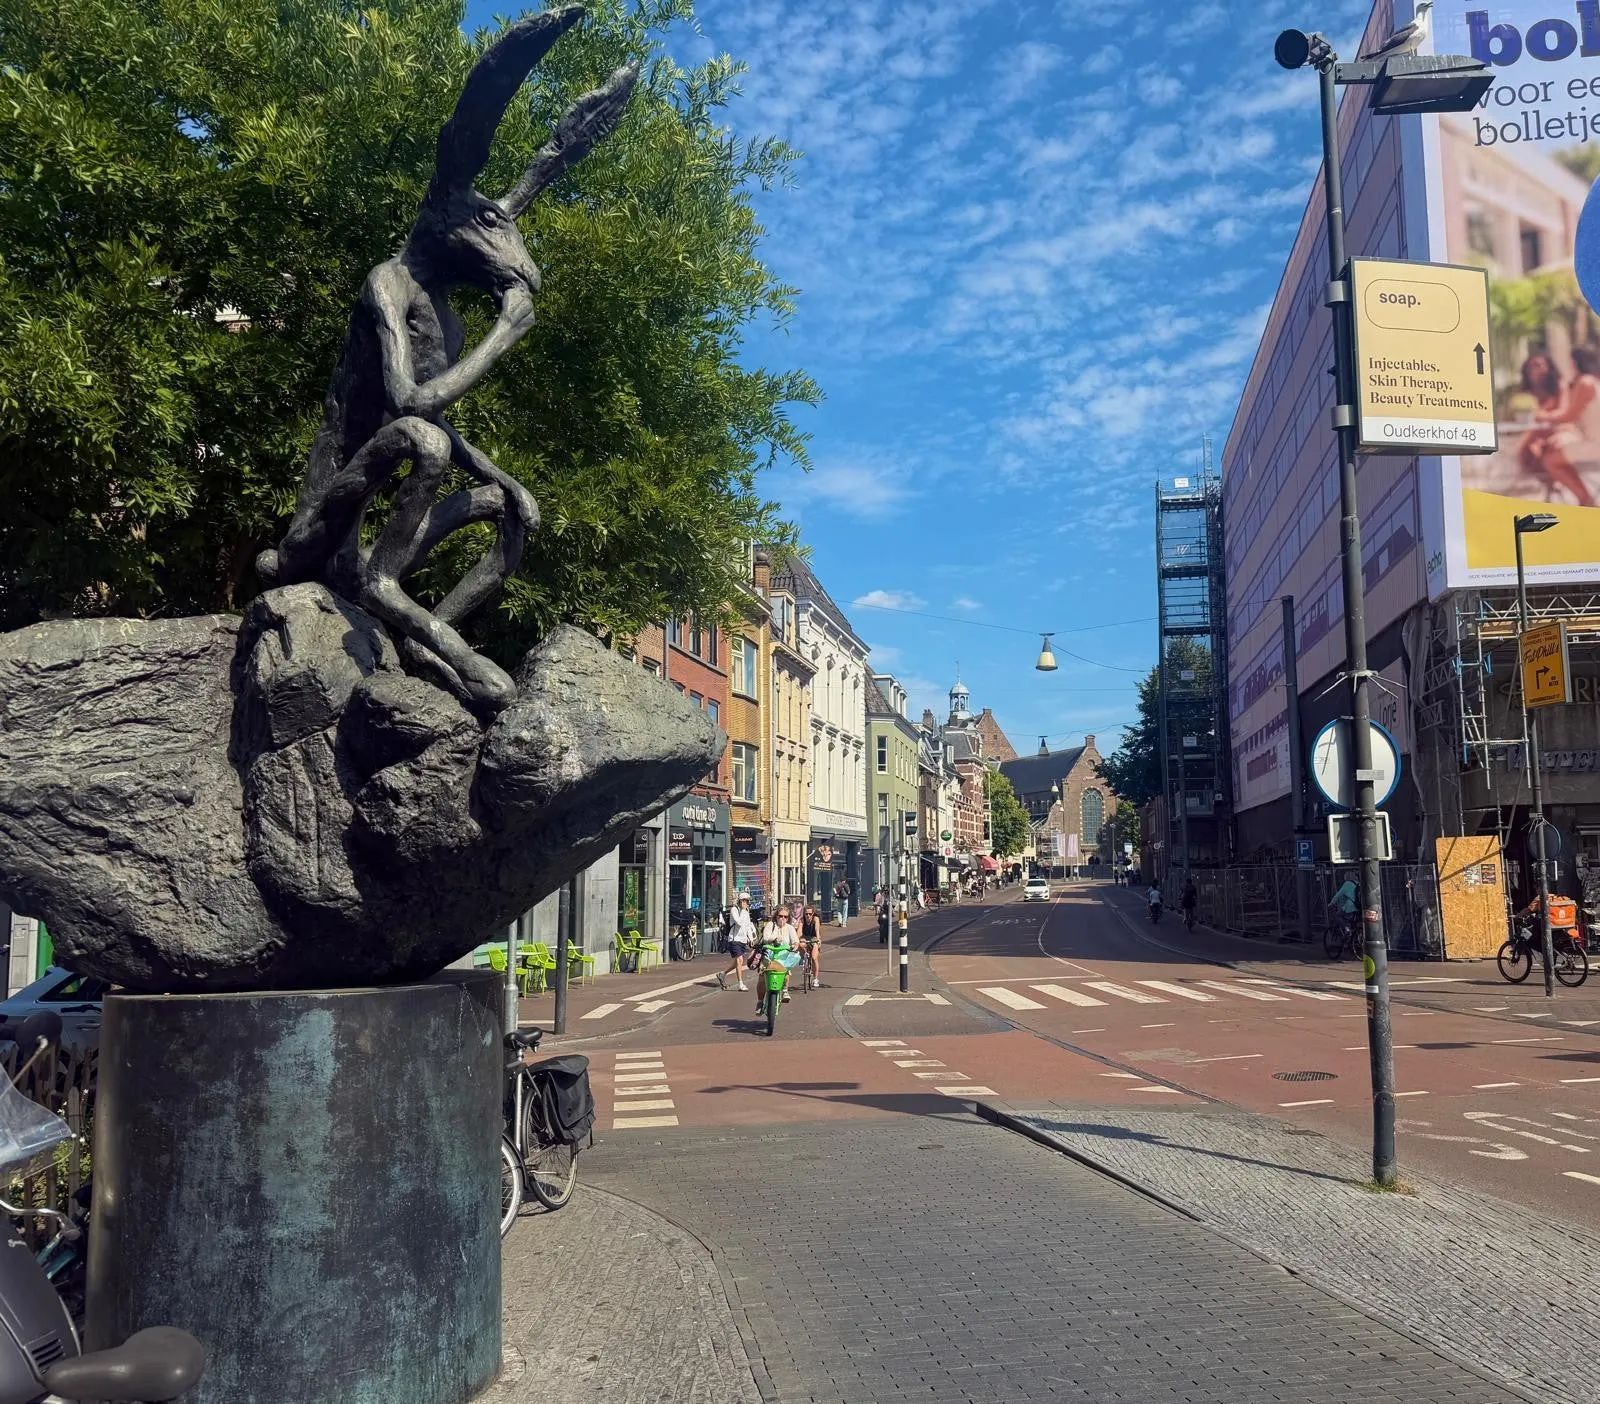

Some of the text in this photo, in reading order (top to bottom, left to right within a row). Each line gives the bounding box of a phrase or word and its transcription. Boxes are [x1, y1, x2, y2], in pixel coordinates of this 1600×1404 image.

[1379, 292, 1421, 309] soap.
[1369, 357, 1440, 372] Injectables.
[1369, 375, 1453, 393] Skin Therapy.
[1370, 392, 1488, 410] Beauty Treatments.
[1383, 423, 1477, 441] Oudkerkhof 48
